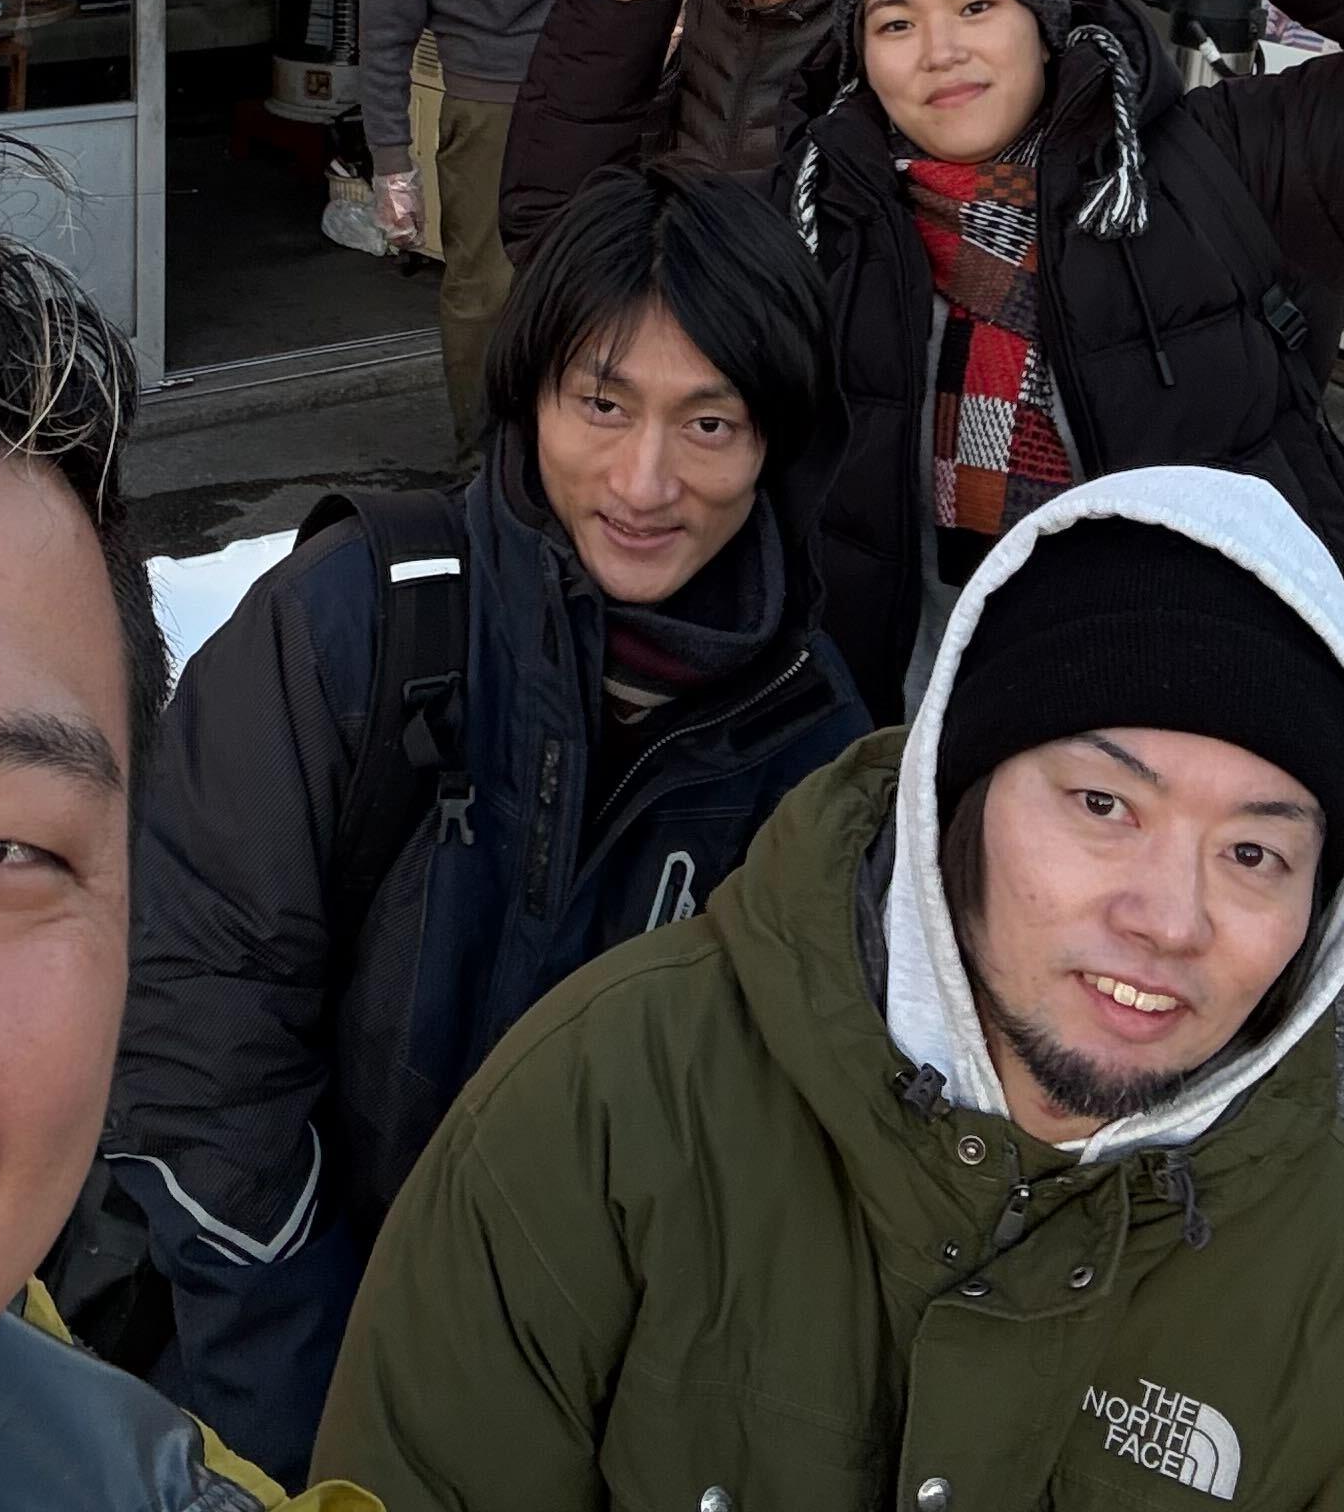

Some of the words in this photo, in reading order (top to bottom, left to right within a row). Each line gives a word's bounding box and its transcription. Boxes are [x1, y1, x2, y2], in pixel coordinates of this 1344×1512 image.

[1081, 1385, 1193, 1453] NORTH
[1138, 1377, 1200, 1426] THE
[1104, 1423, 1186, 1479] FACE
